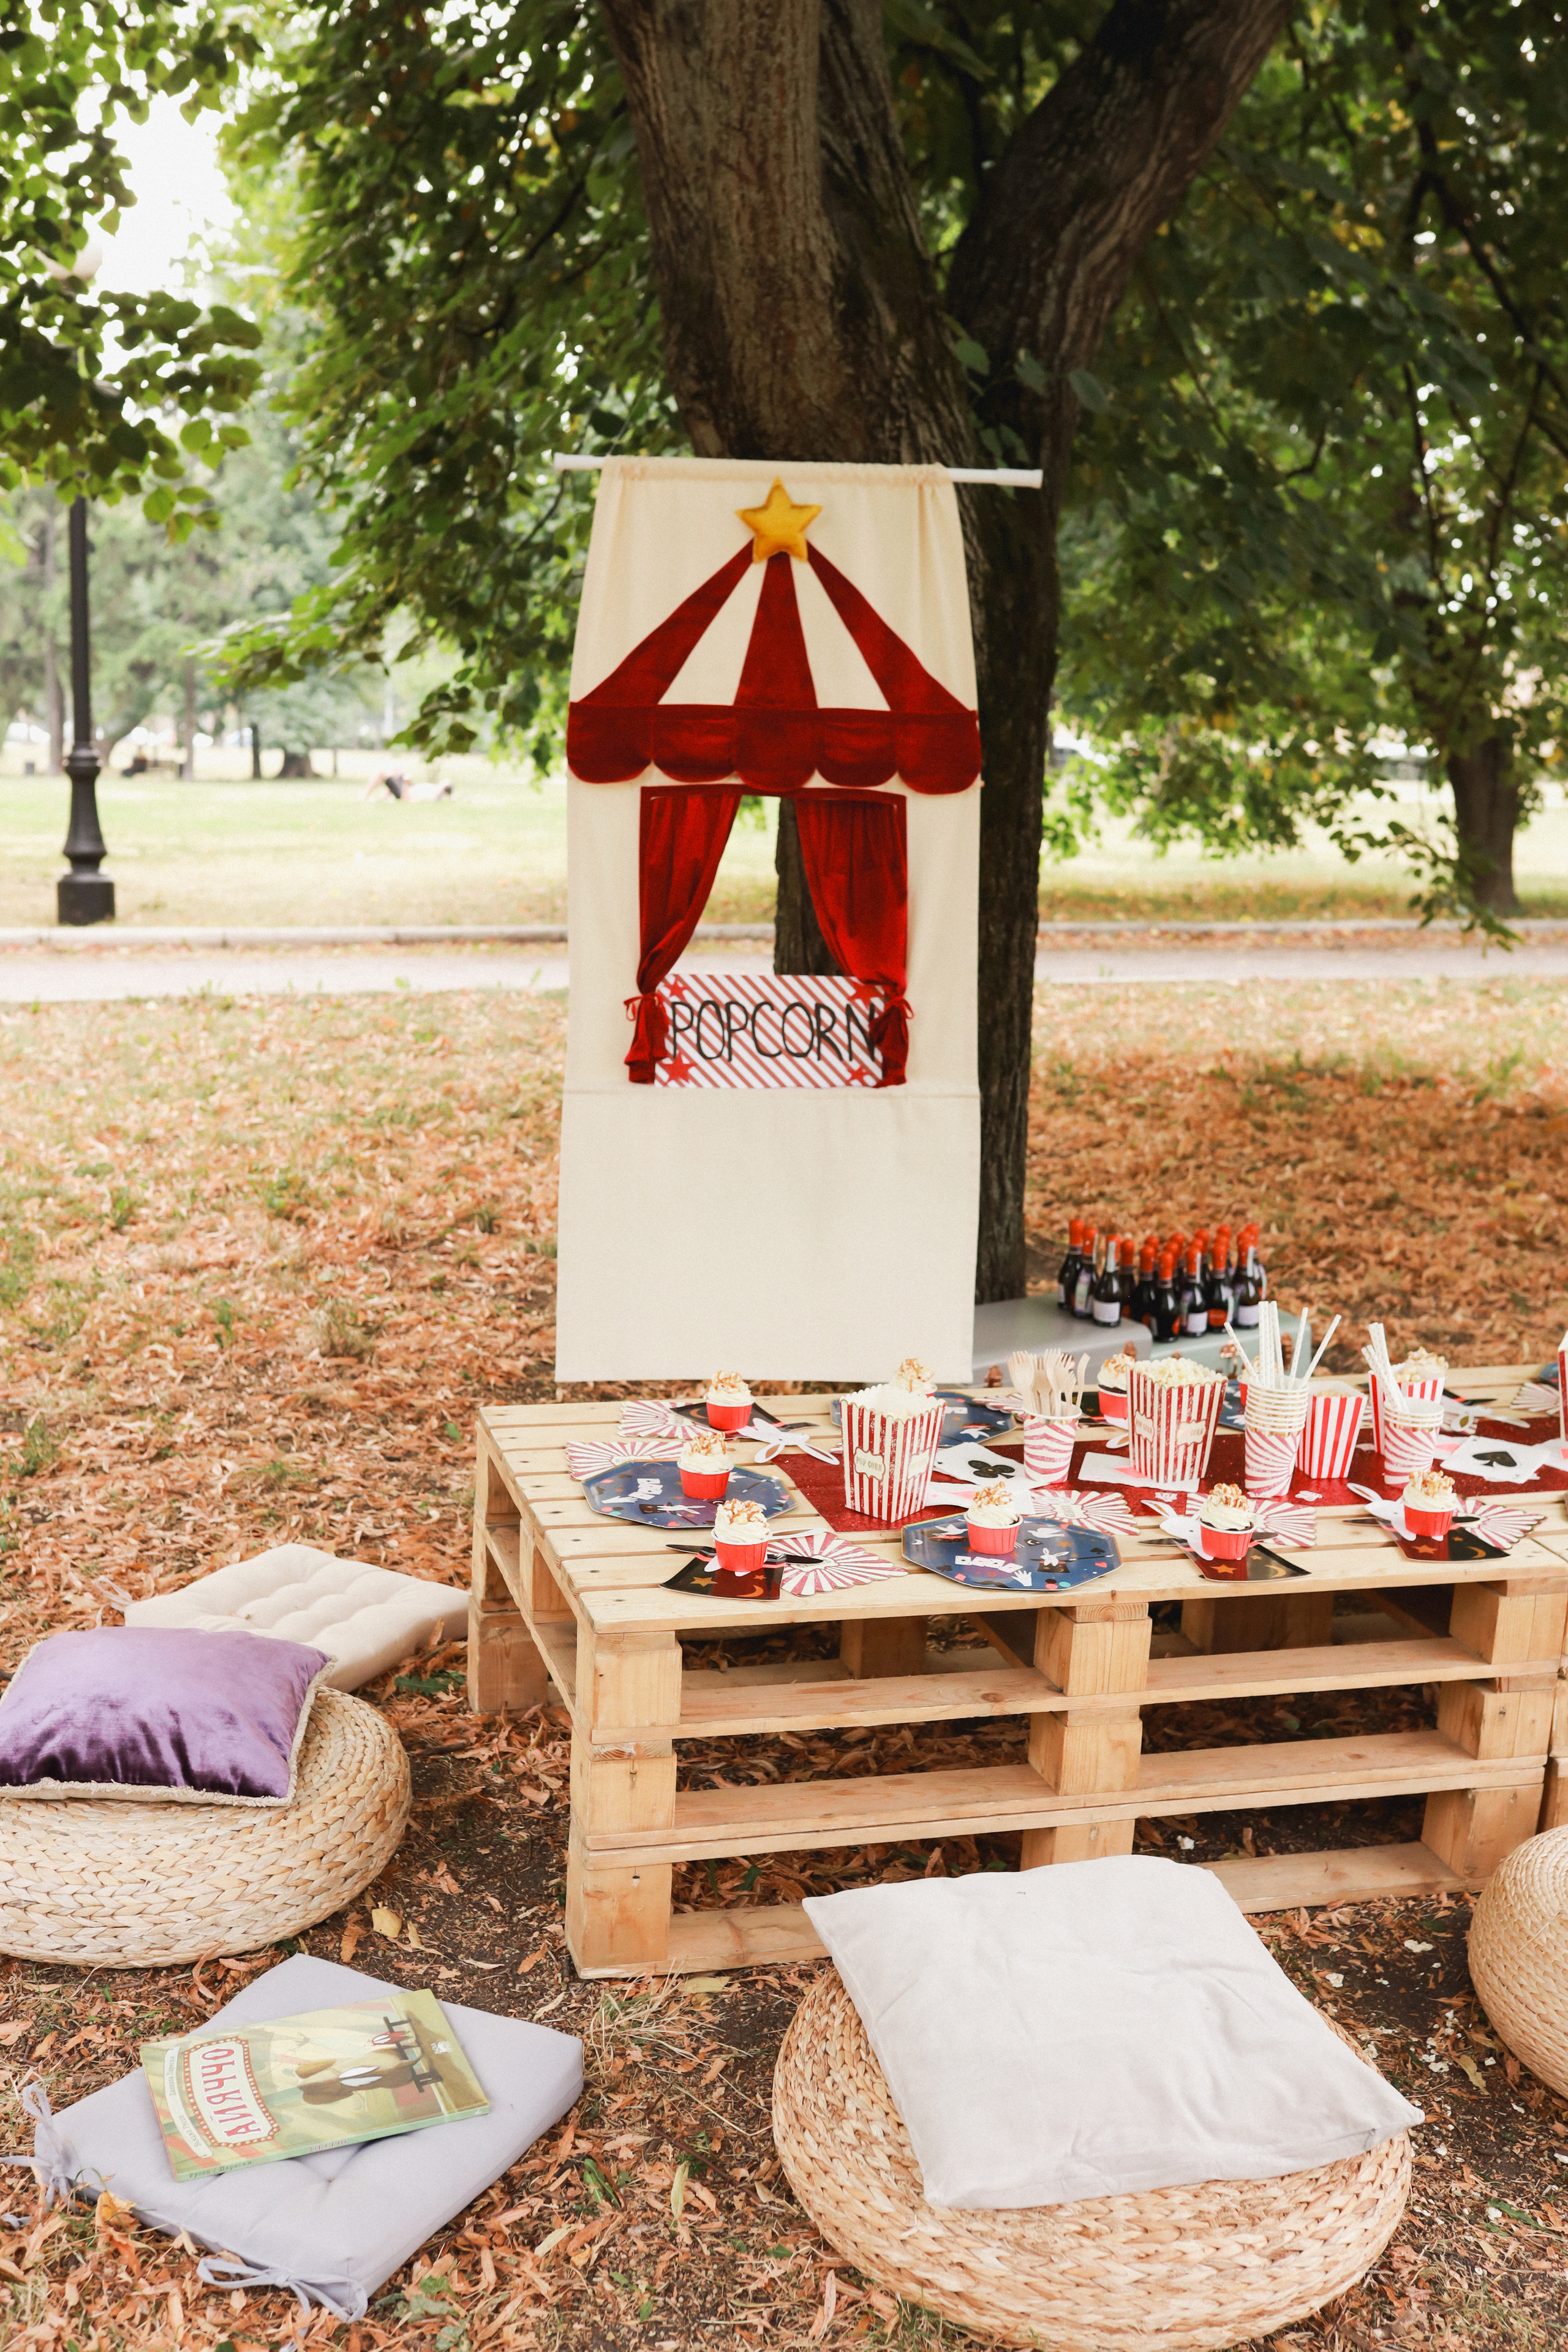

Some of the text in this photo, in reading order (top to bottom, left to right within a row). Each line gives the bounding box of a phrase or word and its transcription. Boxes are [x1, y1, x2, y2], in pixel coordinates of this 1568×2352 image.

[671, 1000, 876, 1061] POPCORN
[856, 1457, 882, 1471] POP CORN
[200, 2048, 262, 2137] АЙЯЧЧО
